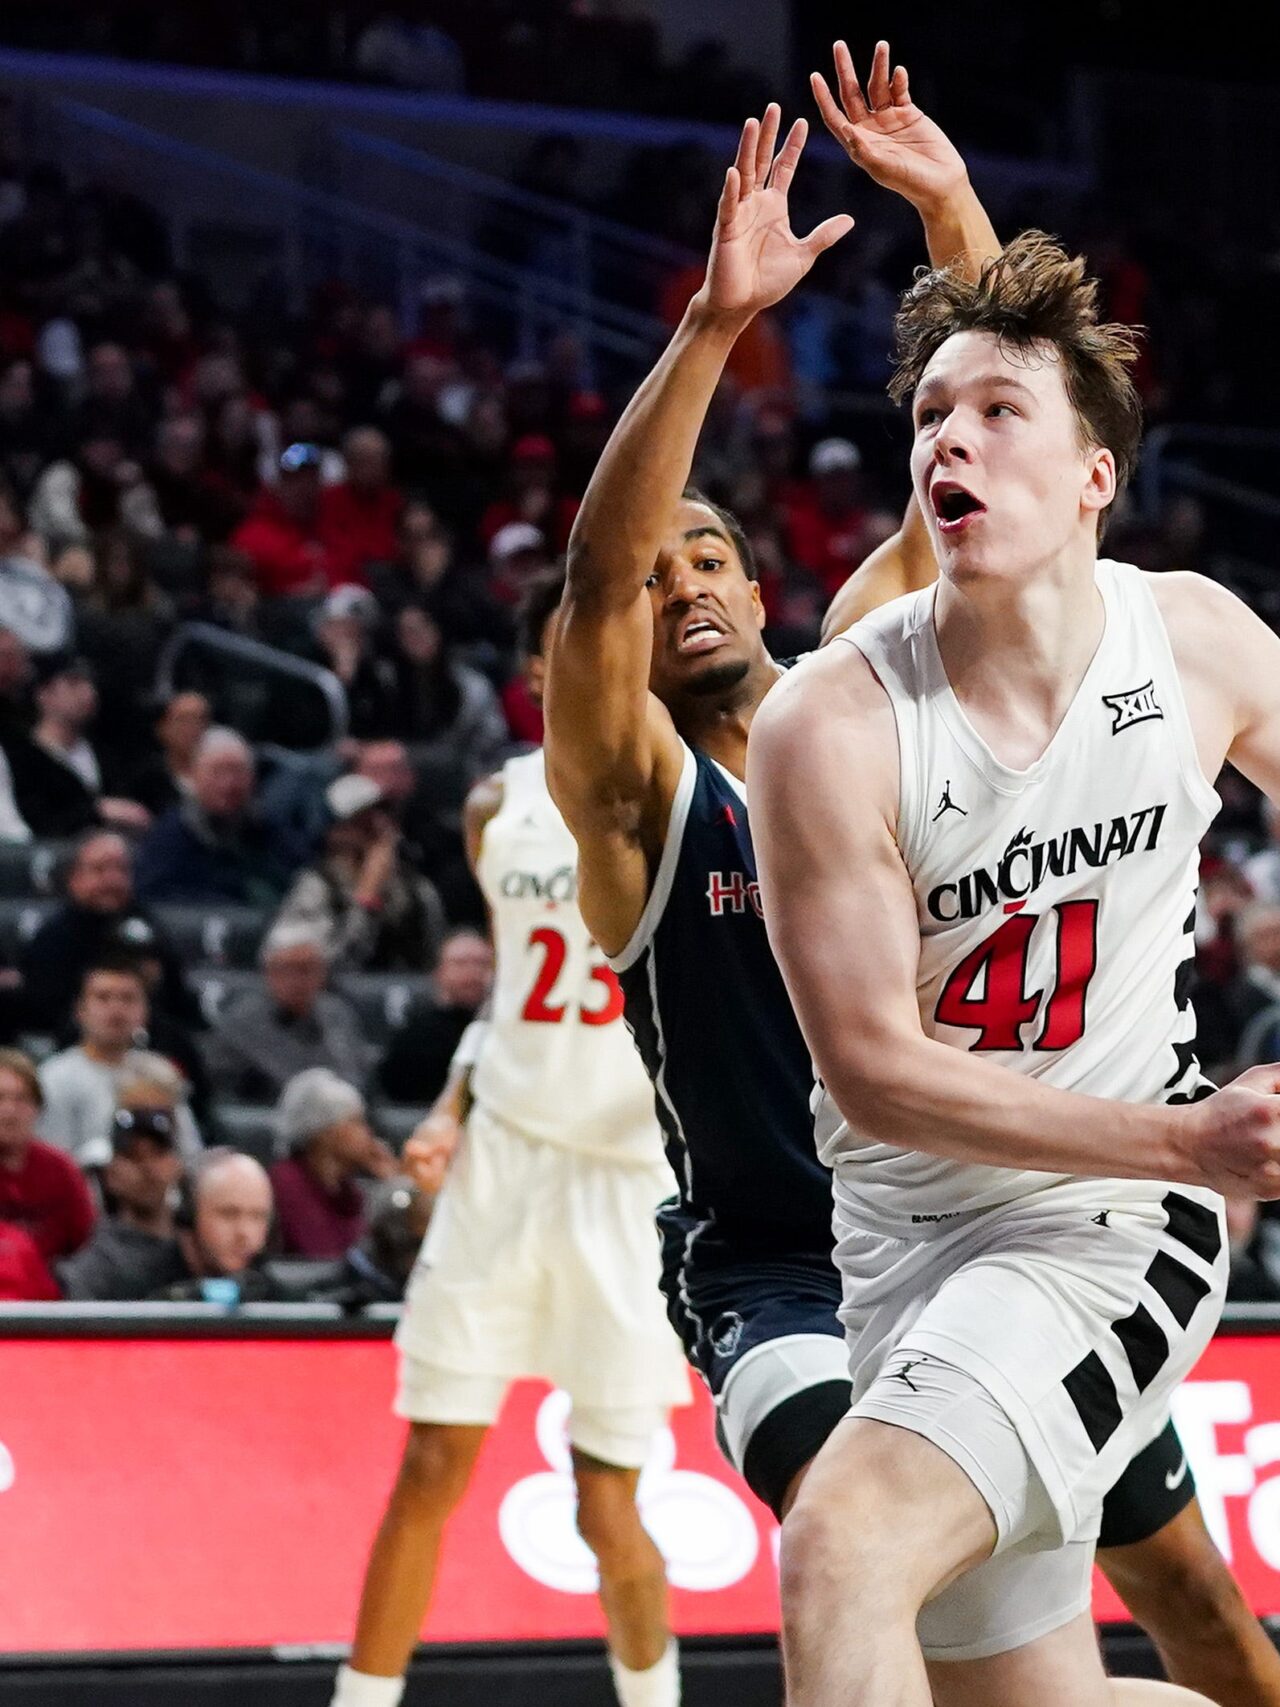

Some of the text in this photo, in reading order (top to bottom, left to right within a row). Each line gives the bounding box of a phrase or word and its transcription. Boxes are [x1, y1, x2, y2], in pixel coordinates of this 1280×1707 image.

[927, 803, 1168, 922] CINCINNATI
[521, 926, 625, 1026] 23
[934, 898, 1100, 1052] 41
